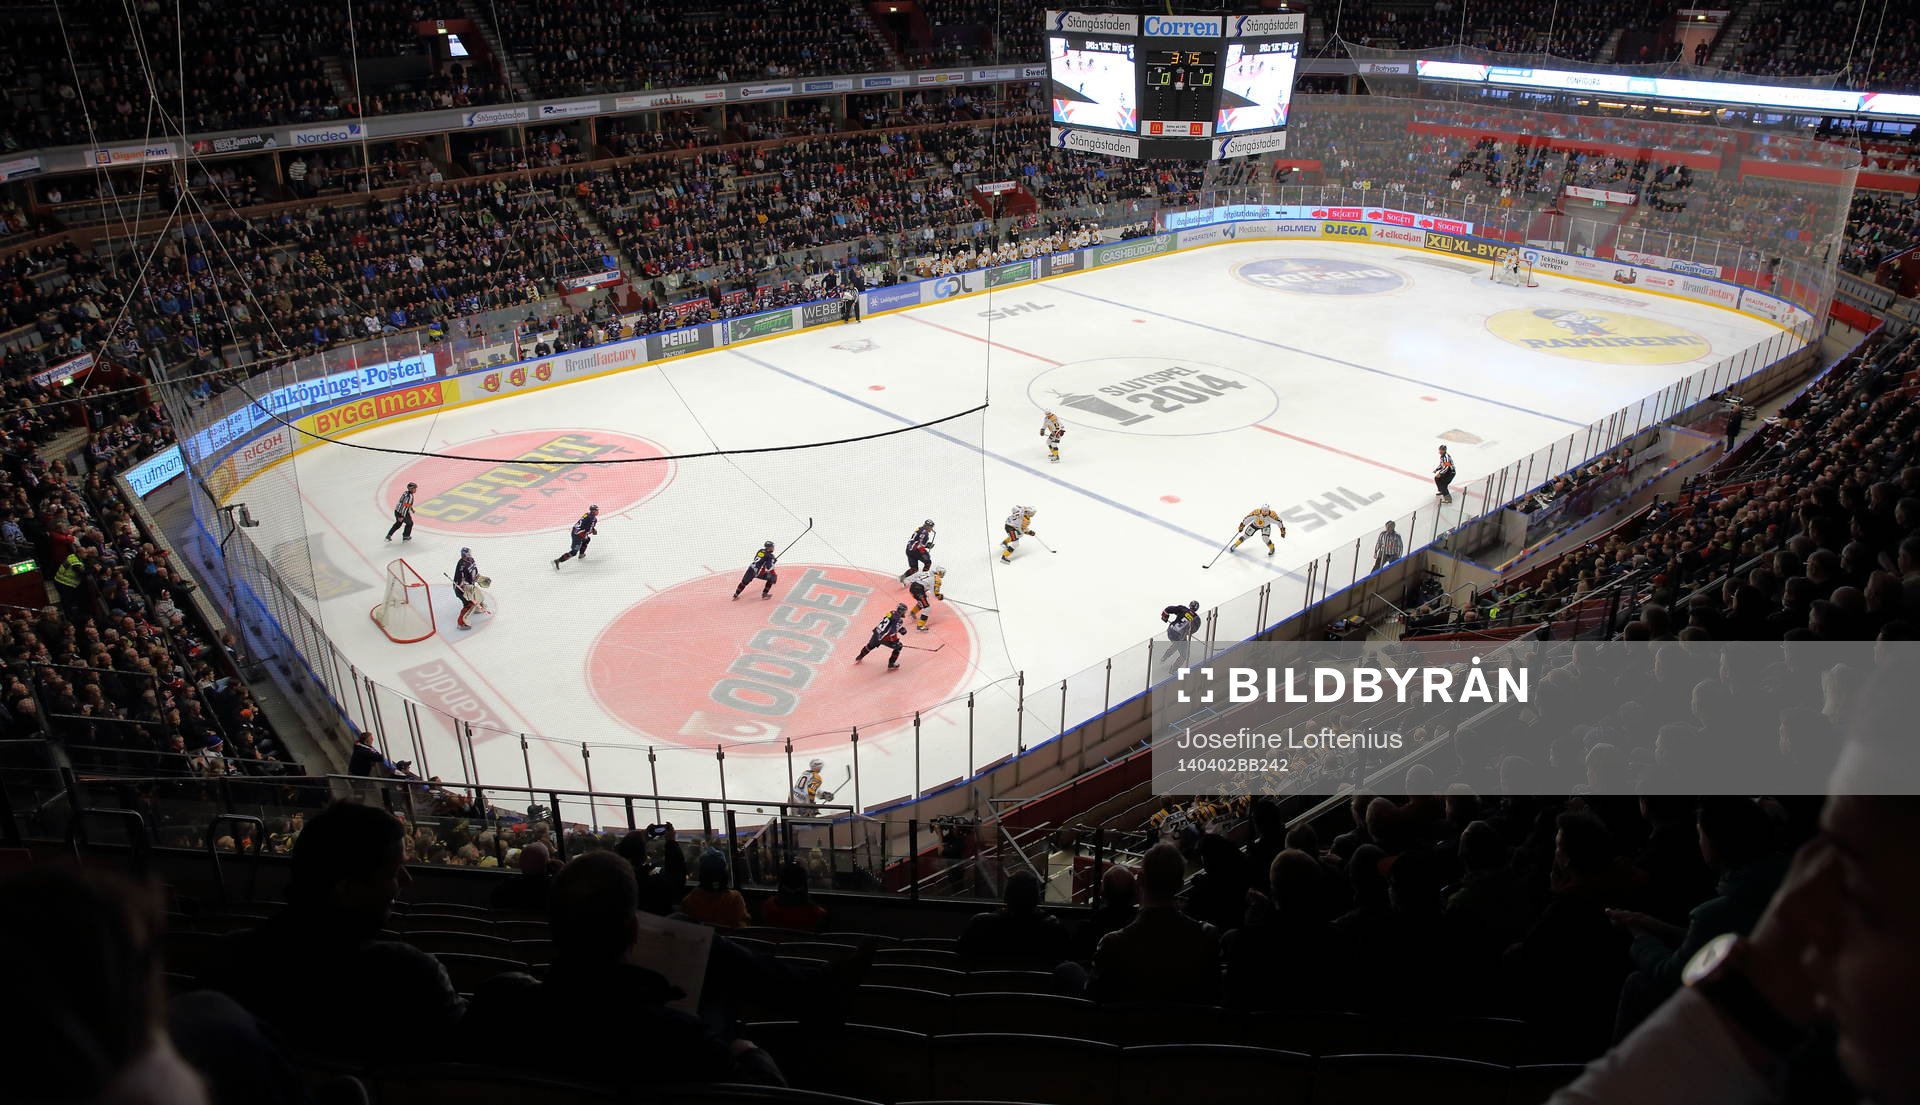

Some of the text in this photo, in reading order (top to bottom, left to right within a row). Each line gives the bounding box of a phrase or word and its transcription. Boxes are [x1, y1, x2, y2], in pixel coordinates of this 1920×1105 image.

[1067, 15, 1130, 32] Stångåstaden
[1144, 16, 1219, 36] Corren
[1246, 17, 1298, 35] Stångåstaden
[1026, 66, 1047, 76] Swed
[476, 111, 526, 123] Stångåstaden
[297, 131, 348, 144] Nordea
[1070, 134, 1131, 153] Stångåstaden
[1229, 136, 1280, 153] Stångåstaden
[1276, 224, 1317, 232] HOLMEN
[1325, 224, 1368, 237] DJEGA
[1051, 252, 1075, 266] PEMA
[1102, 243, 1157, 262] CASHBUDDY
[1541, 255, 1569, 266] Tekniska
[977, 300, 1057, 322] SHL
[661, 328, 699, 348] PEMA
[565, 348, 637, 372] BrandFactory
[1098, 365, 1200, 398] SLUTSPEL
[1130, 374, 1248, 416] 2014
[244, 433, 283, 462] RICOH
[416, 434, 612, 523] SPORT
[1282, 485, 1386, 533] SHL
[709, 567, 875, 718] ODDSET
